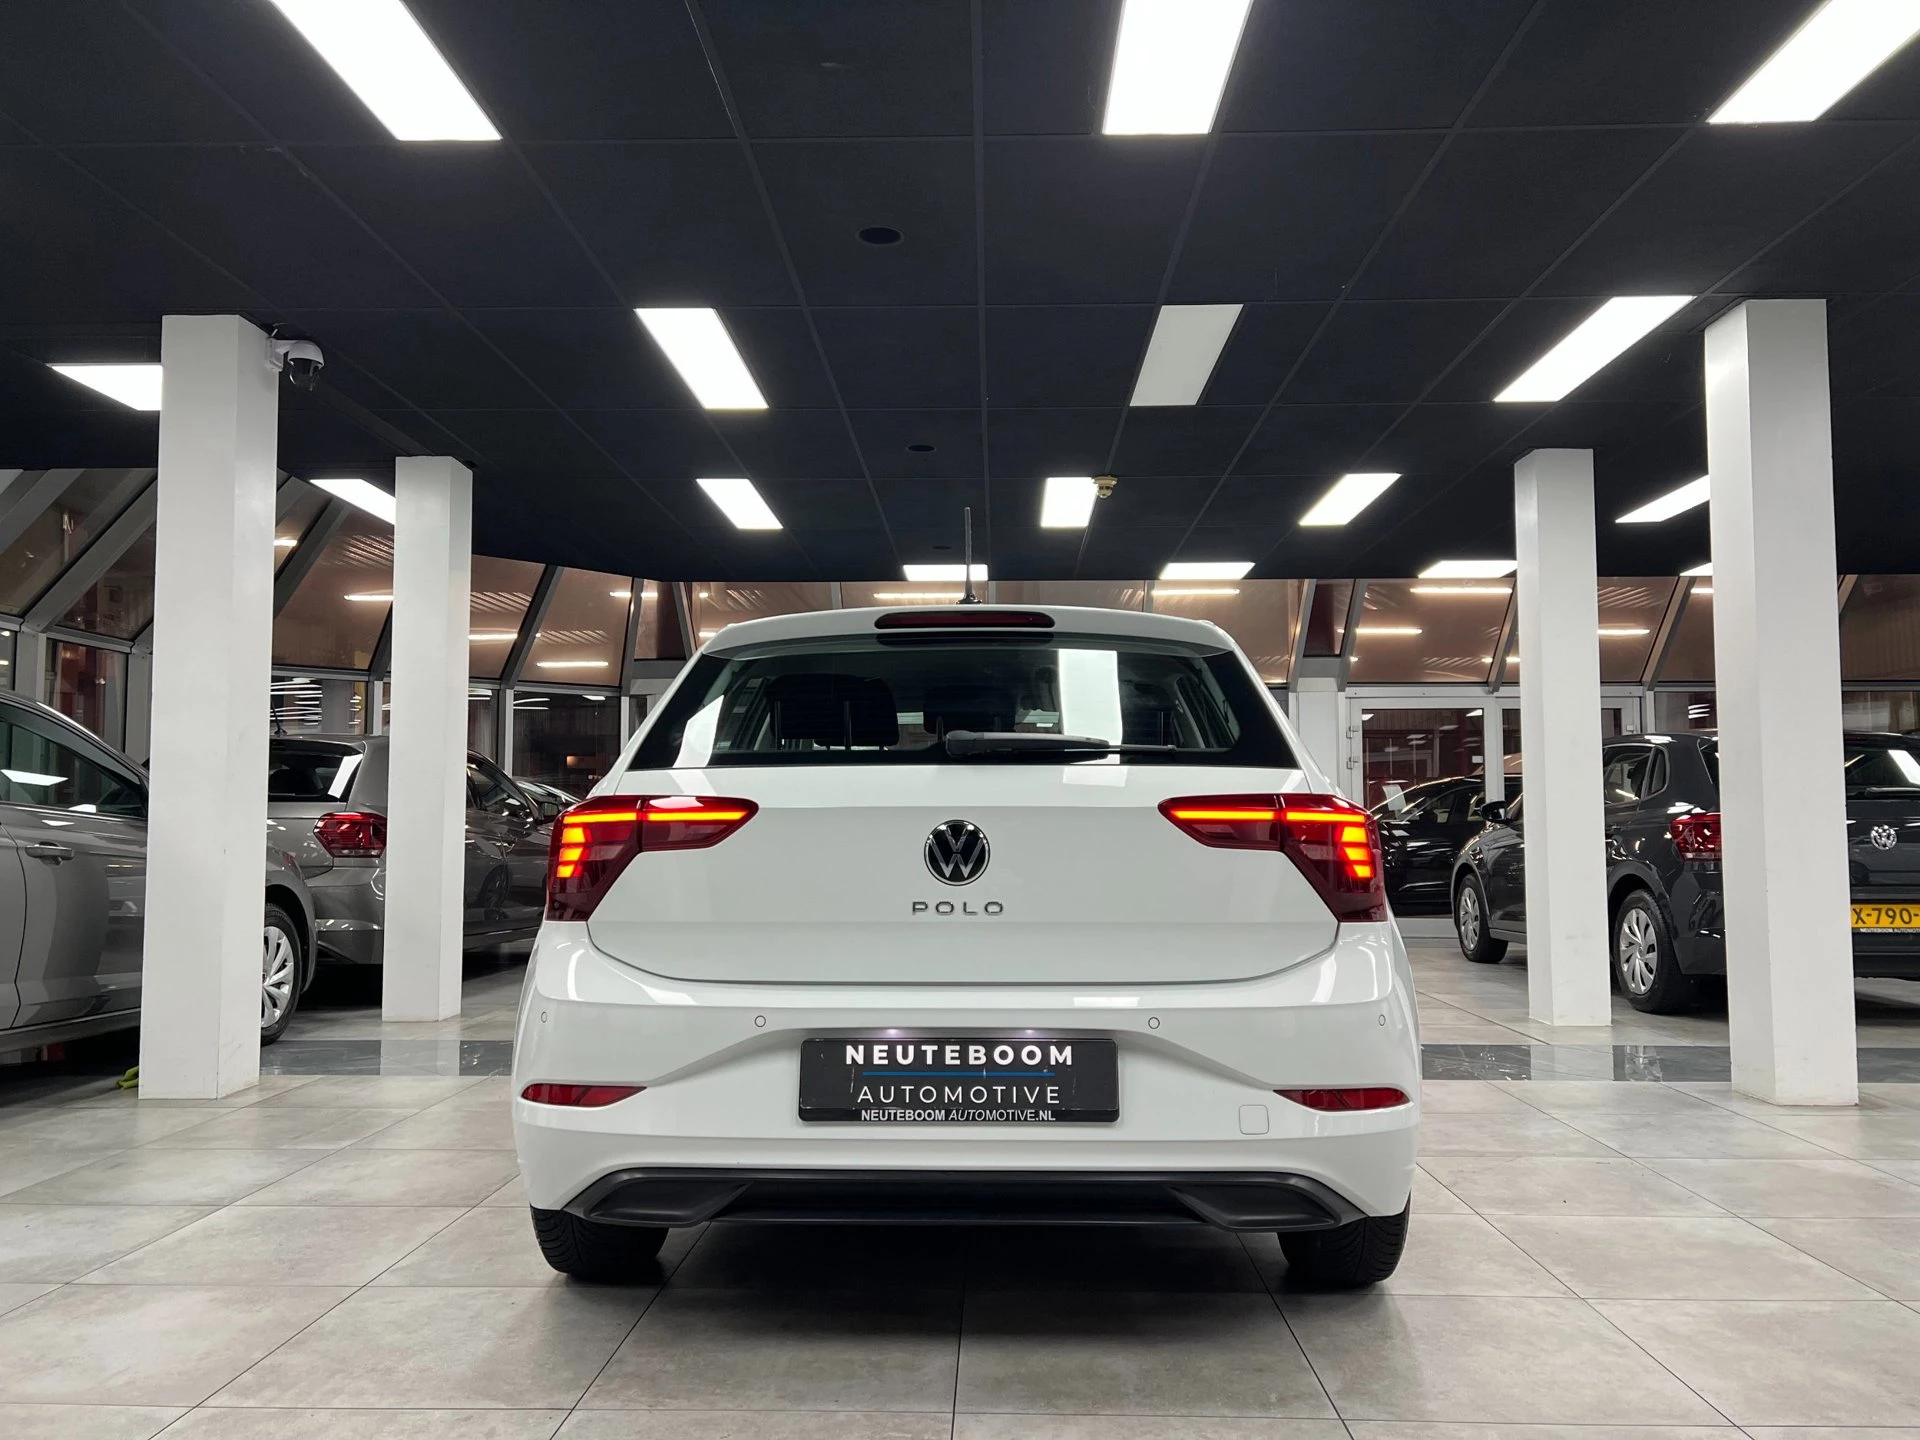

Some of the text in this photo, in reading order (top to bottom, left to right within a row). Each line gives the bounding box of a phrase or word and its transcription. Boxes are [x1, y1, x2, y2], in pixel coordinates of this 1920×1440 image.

[928, 823, 986, 880] VW
[911, 901, 1004, 916] POLO
[845, 1045, 1073, 1066] NEUTEBOOM
[857, 1085, 1060, 1104] AUTOMOTIVE
[860, 1109, 1056, 1121] NEUTEBOOM AUTOMOTIVE.NL
